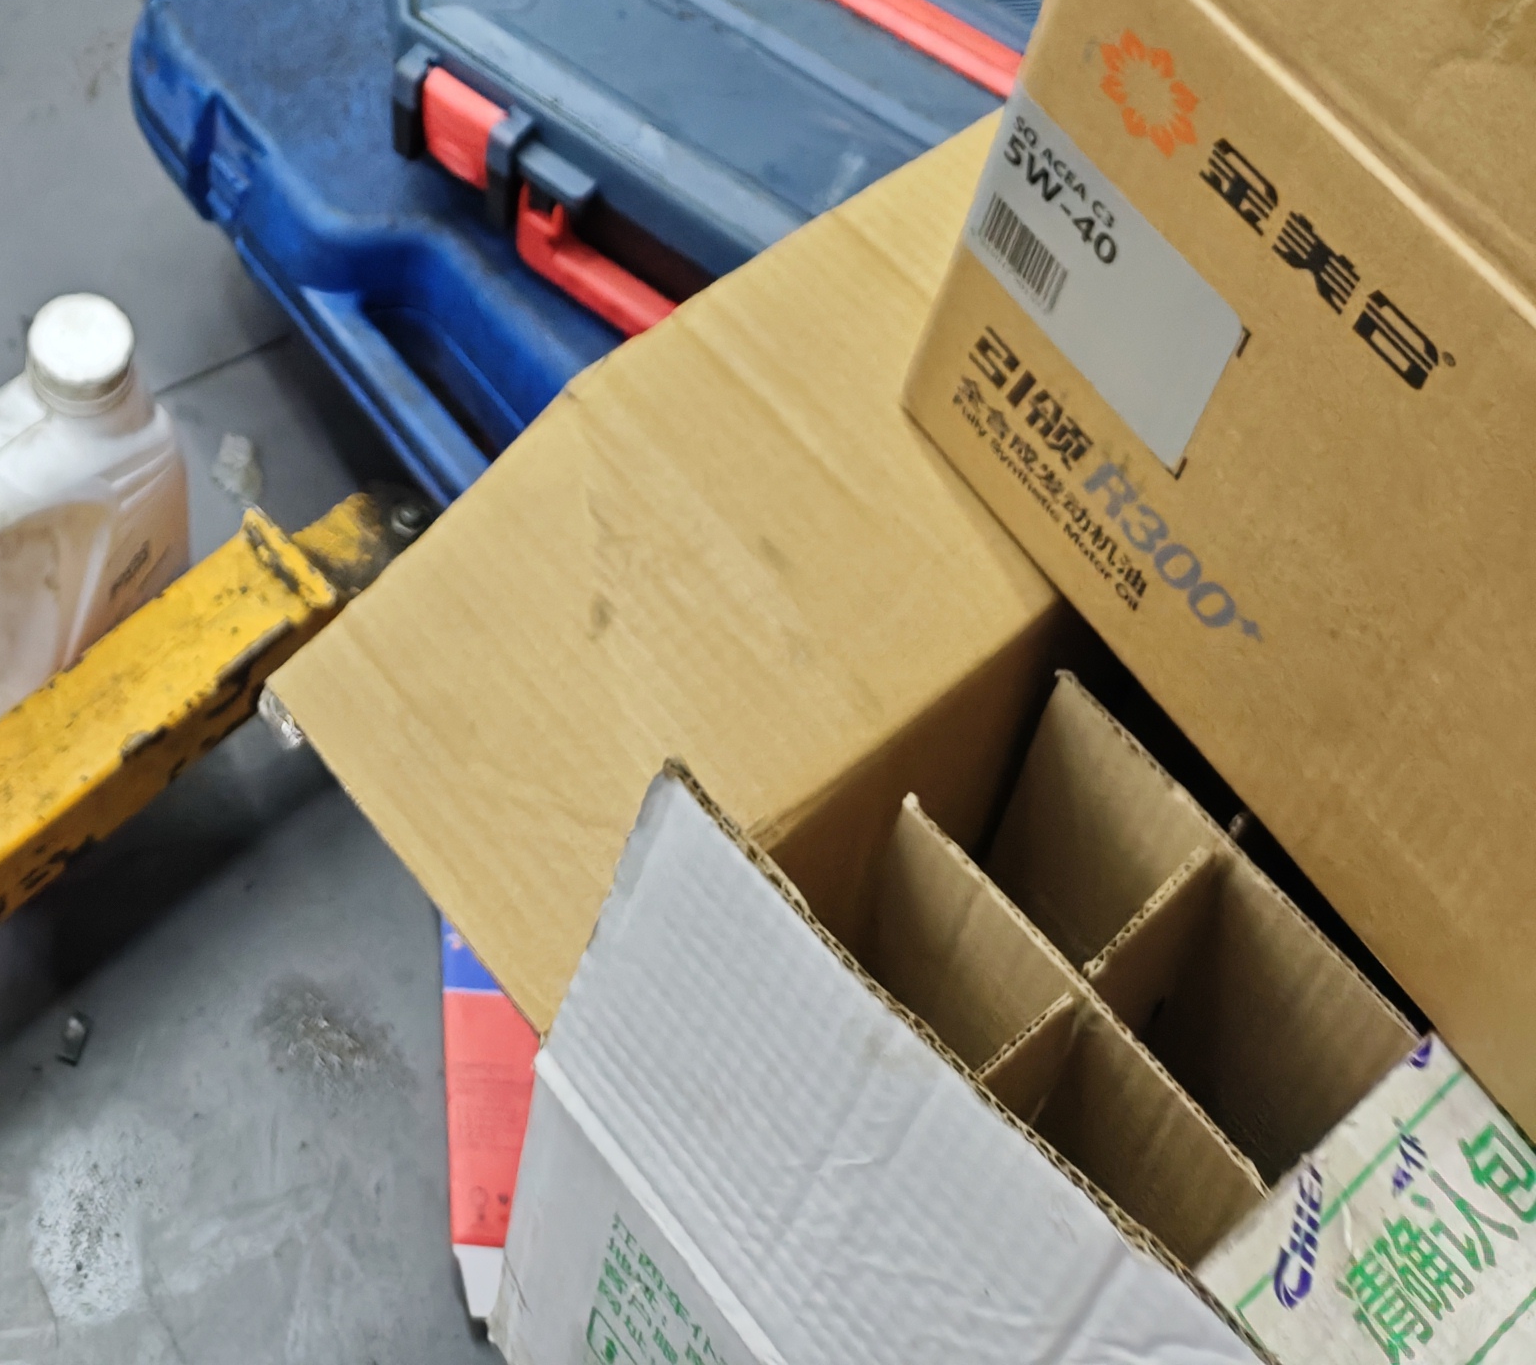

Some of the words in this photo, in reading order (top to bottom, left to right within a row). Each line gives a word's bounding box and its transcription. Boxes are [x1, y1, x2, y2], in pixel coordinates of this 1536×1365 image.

[1003, 132, 1118, 265] 5W-40
[1040, 147, 1088, 203] ACEA
[1198, 138, 1441, 391] 金美合
[952, 392, 988, 439] Fully
[989, 435, 1061, 524] Synthetic
[1062, 522, 1113, 581] Motor
[1114, 581, 1140, 613] Oil
[955, 374, 1149, 600] 全合成发动机油
[611, 1211, 727, 1365] 江西车仆
